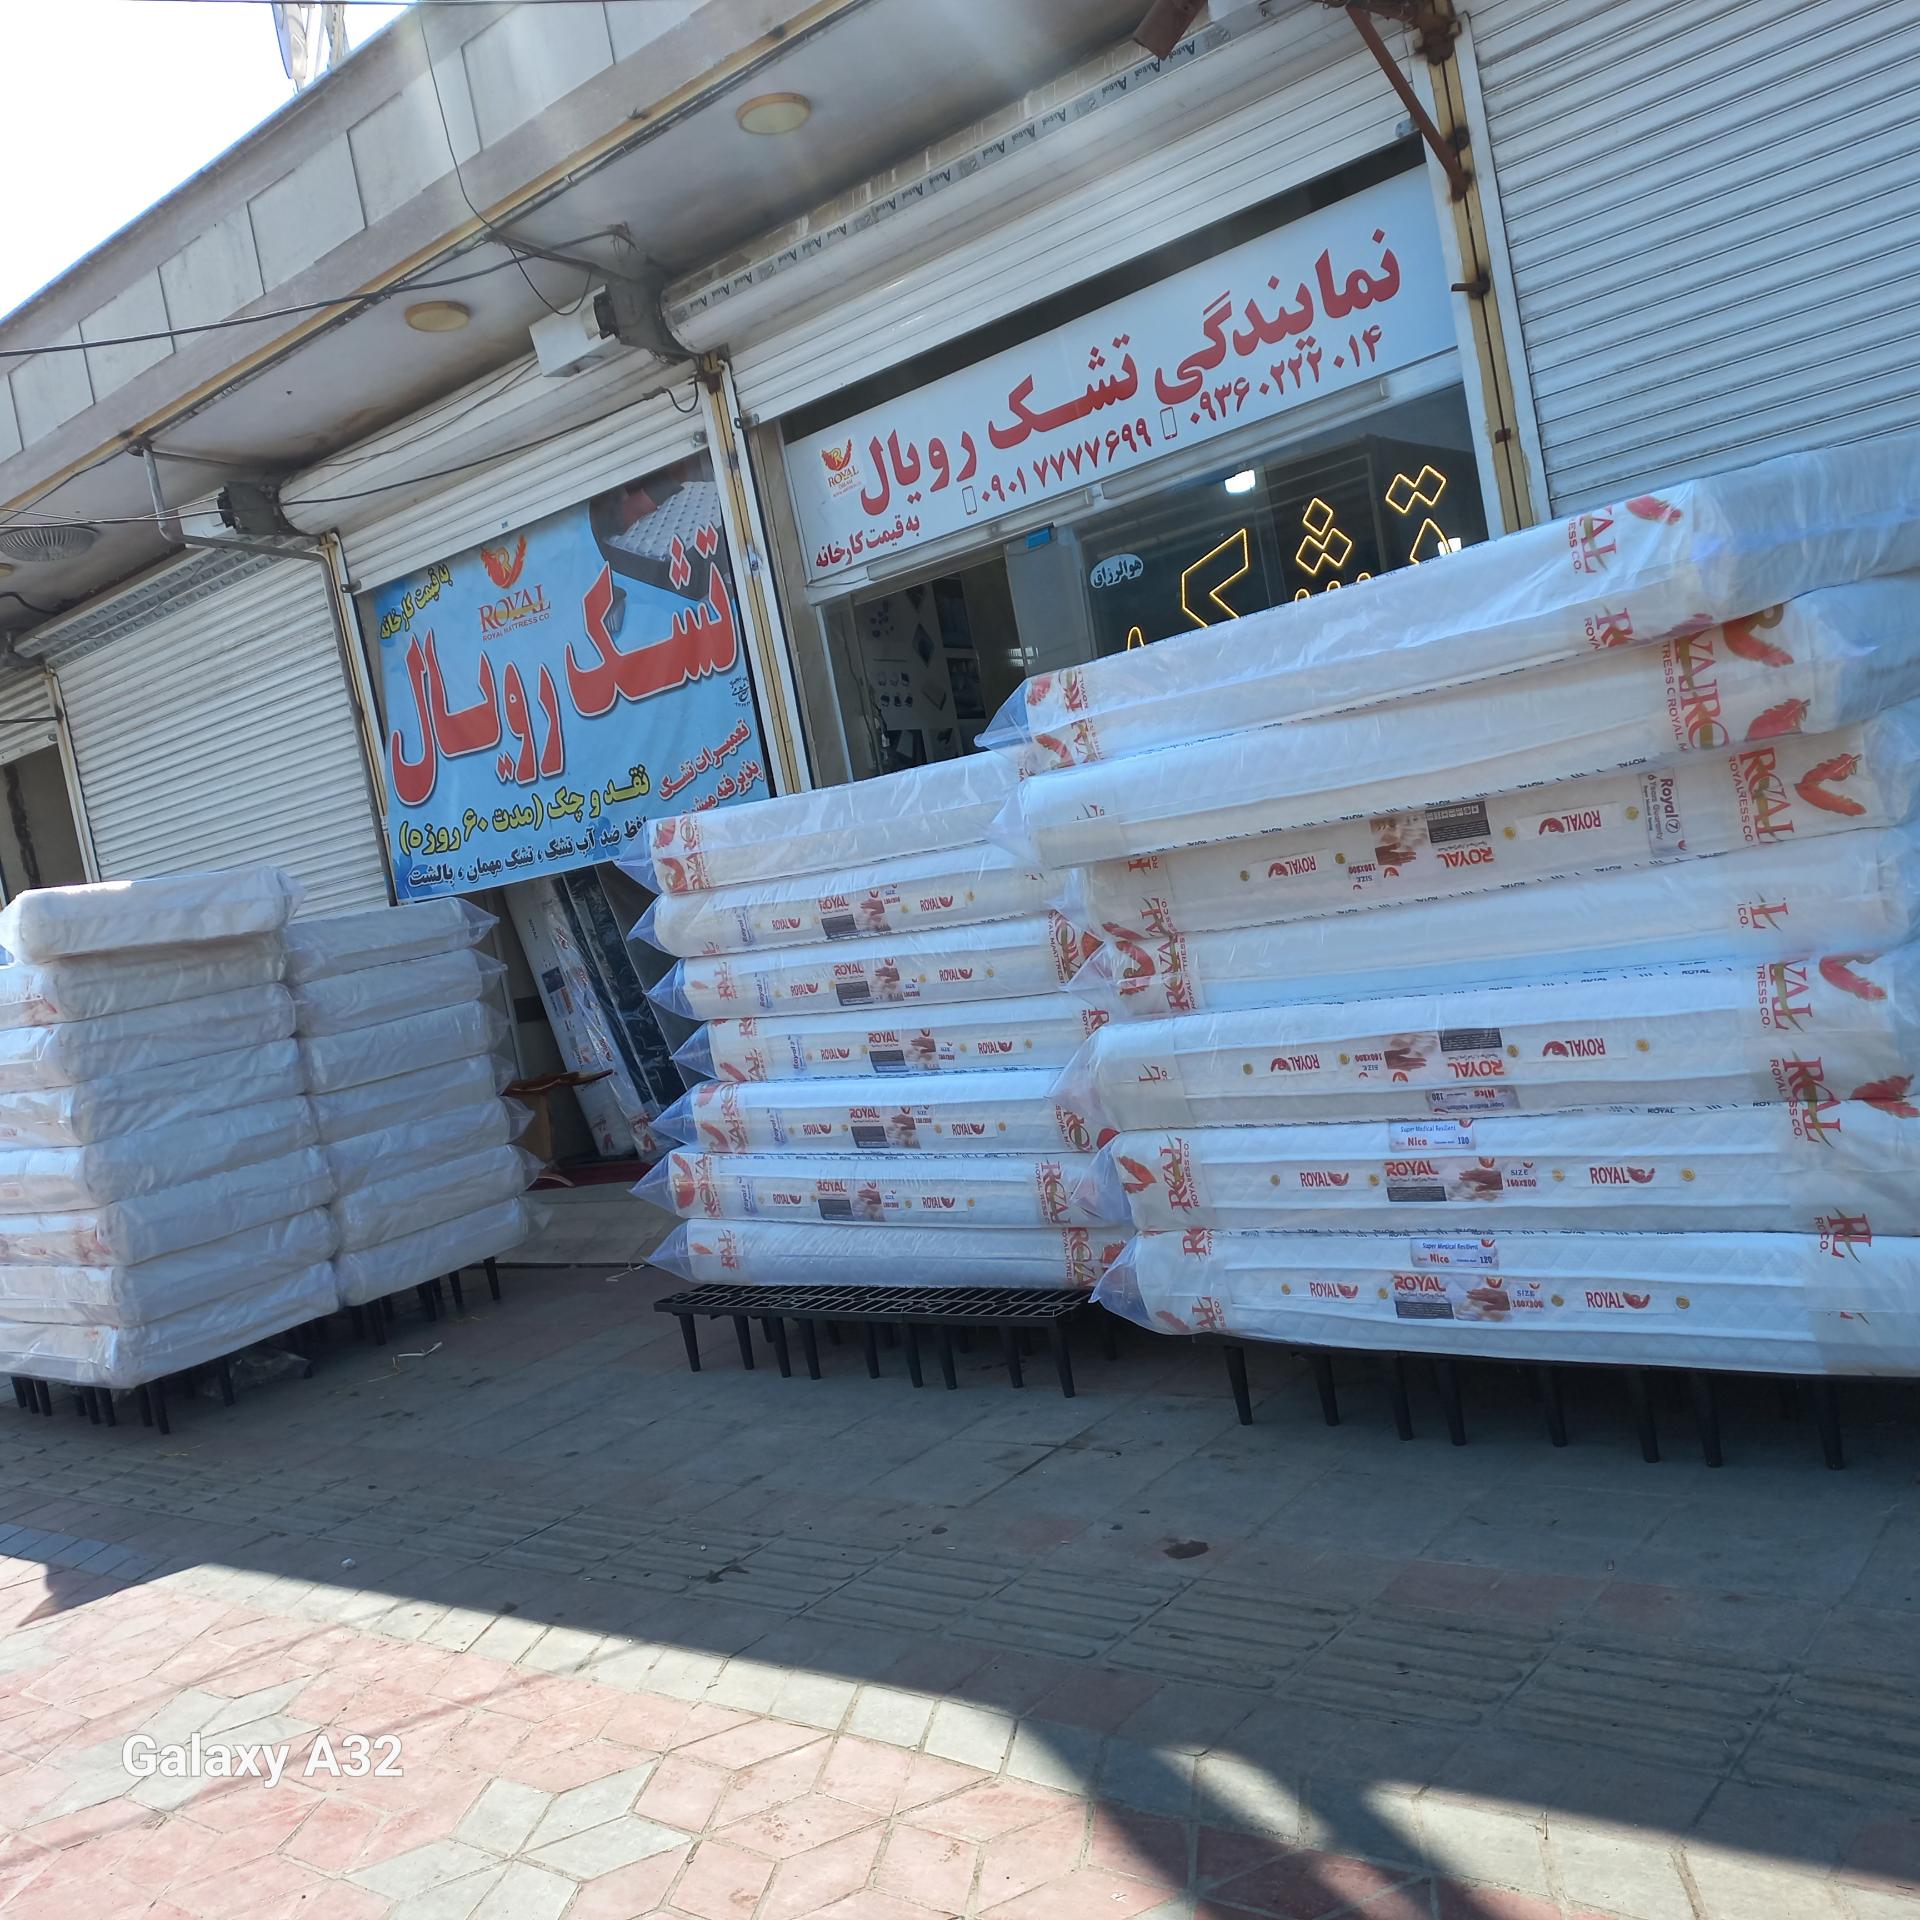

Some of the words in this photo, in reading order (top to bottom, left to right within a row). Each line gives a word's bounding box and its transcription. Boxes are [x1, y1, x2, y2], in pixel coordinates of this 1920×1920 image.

[1155, 228, 1401, 405] نمایندگی
[988, 333, 1138, 450] تشک
[860, 428, 977, 516] رویال
[866, 515, 904, 548] قیمت
[906, 515, 920, 537] به
[816, 530, 864, 567] کارخانه
[478, 584, 551, 633] ROYAL
[565, 522, 738, 717] تشک
[391, 630, 566, 807] رویال
[695, 718, 751, 774] تعمیرات
[603, 764, 651, 805] نقد
[658, 760, 697, 800] تشک
[547, 786, 584, 824] چک
[590, 790, 601, 818] و
[1562, 809, 1602, 835] ROYAL
[1285, 855, 1316, 876] ROYAL
[1437, 847, 1494, 868] ROYAL
[835, 963, 864, 977] ROYAL
[868, 1031, 899, 1044] ROYAL
[1567, 1037, 1607, 1057] ROYAL
[1288, 1054, 1320, 1072] ROYAL
[1447, 1058, 1504, 1078] ROYAL
[849, 1107, 880, 1119] ROYAL
[1384, 1160, 1439, 1176] ROYAL
[1590, 1166, 1629, 1185] ROYAL
[816, 1180, 847, 1193] ROYAL
[1300, 1171, 1331, 1187] ROYAL
[1310, 1281, 1339, 1298] ROYAL
[1393, 1275, 1446, 1292] ROYAL
[1585, 1291, 1624, 1309] ROYAL
